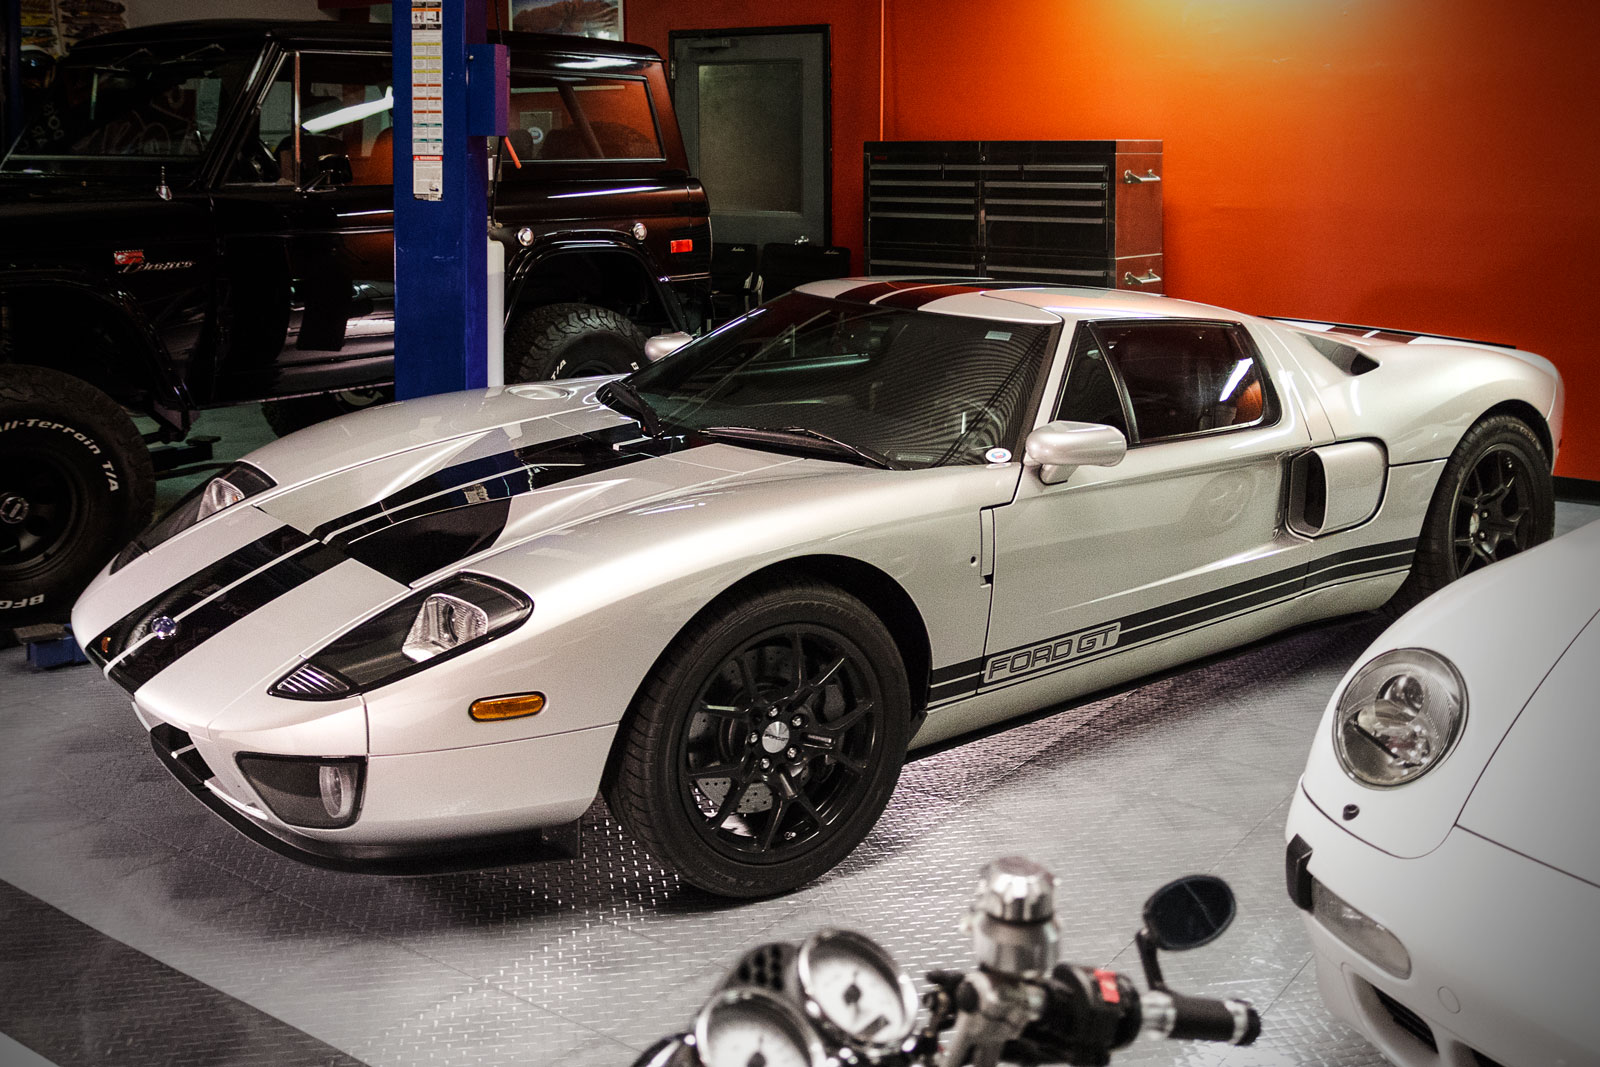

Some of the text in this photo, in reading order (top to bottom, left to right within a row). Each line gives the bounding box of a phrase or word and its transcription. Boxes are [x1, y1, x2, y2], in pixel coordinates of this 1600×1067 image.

[0, 418, 120, 492] ll-Terrain T/A
[987, 624, 1119, 680] FORD GT
